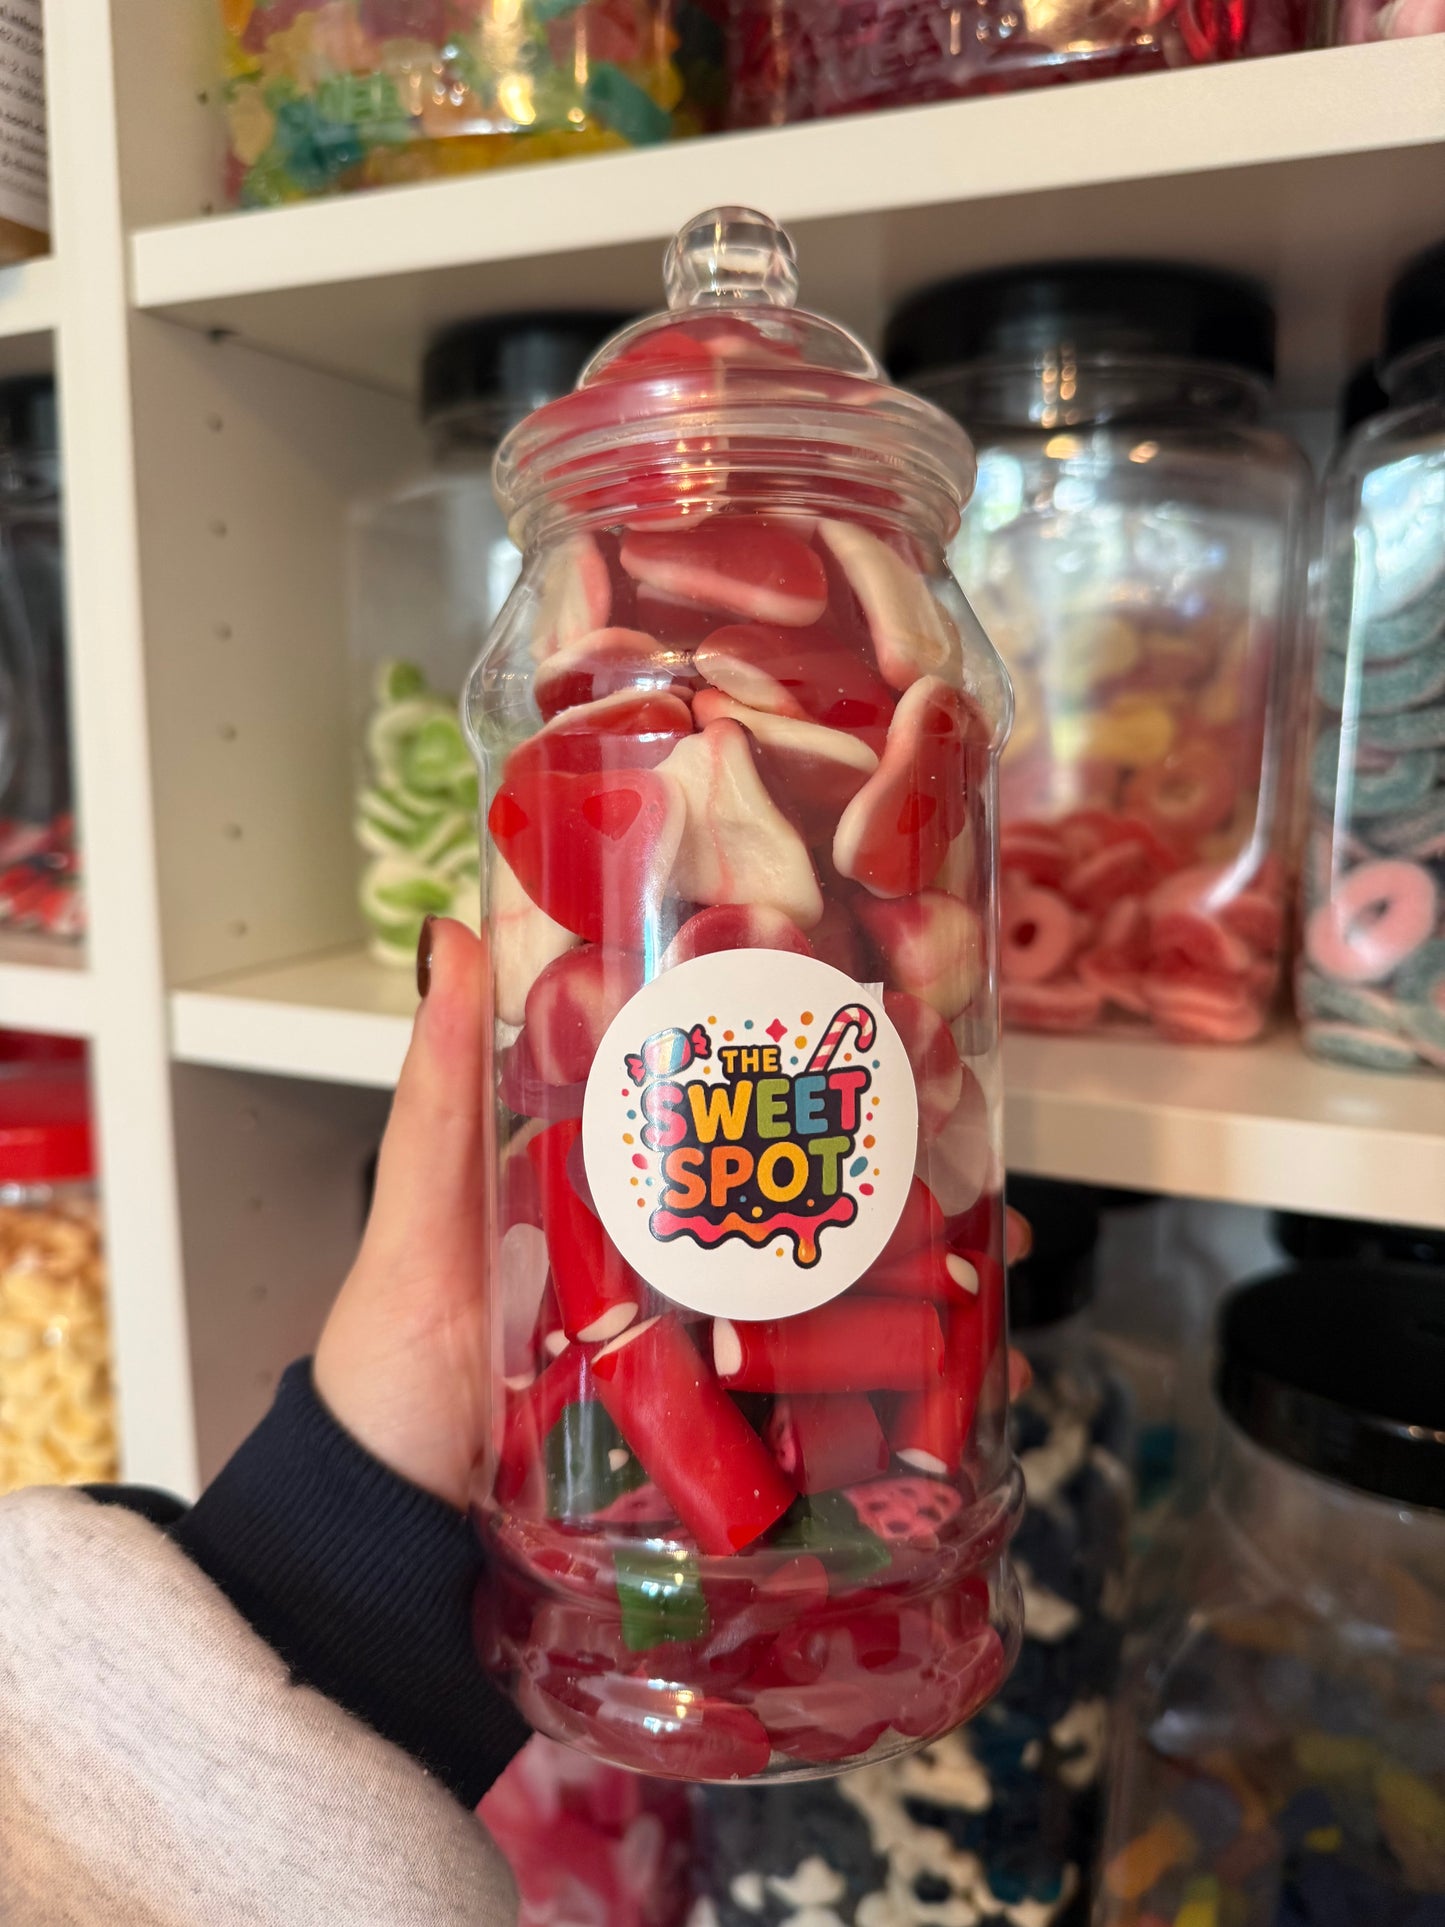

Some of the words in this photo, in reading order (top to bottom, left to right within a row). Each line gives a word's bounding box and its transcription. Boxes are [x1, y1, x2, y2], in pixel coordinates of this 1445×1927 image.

[722, 1049, 779, 1073] THE
[645, 1071, 867, 1146] SWEET
[664, 1136, 850, 1209] SPOT
